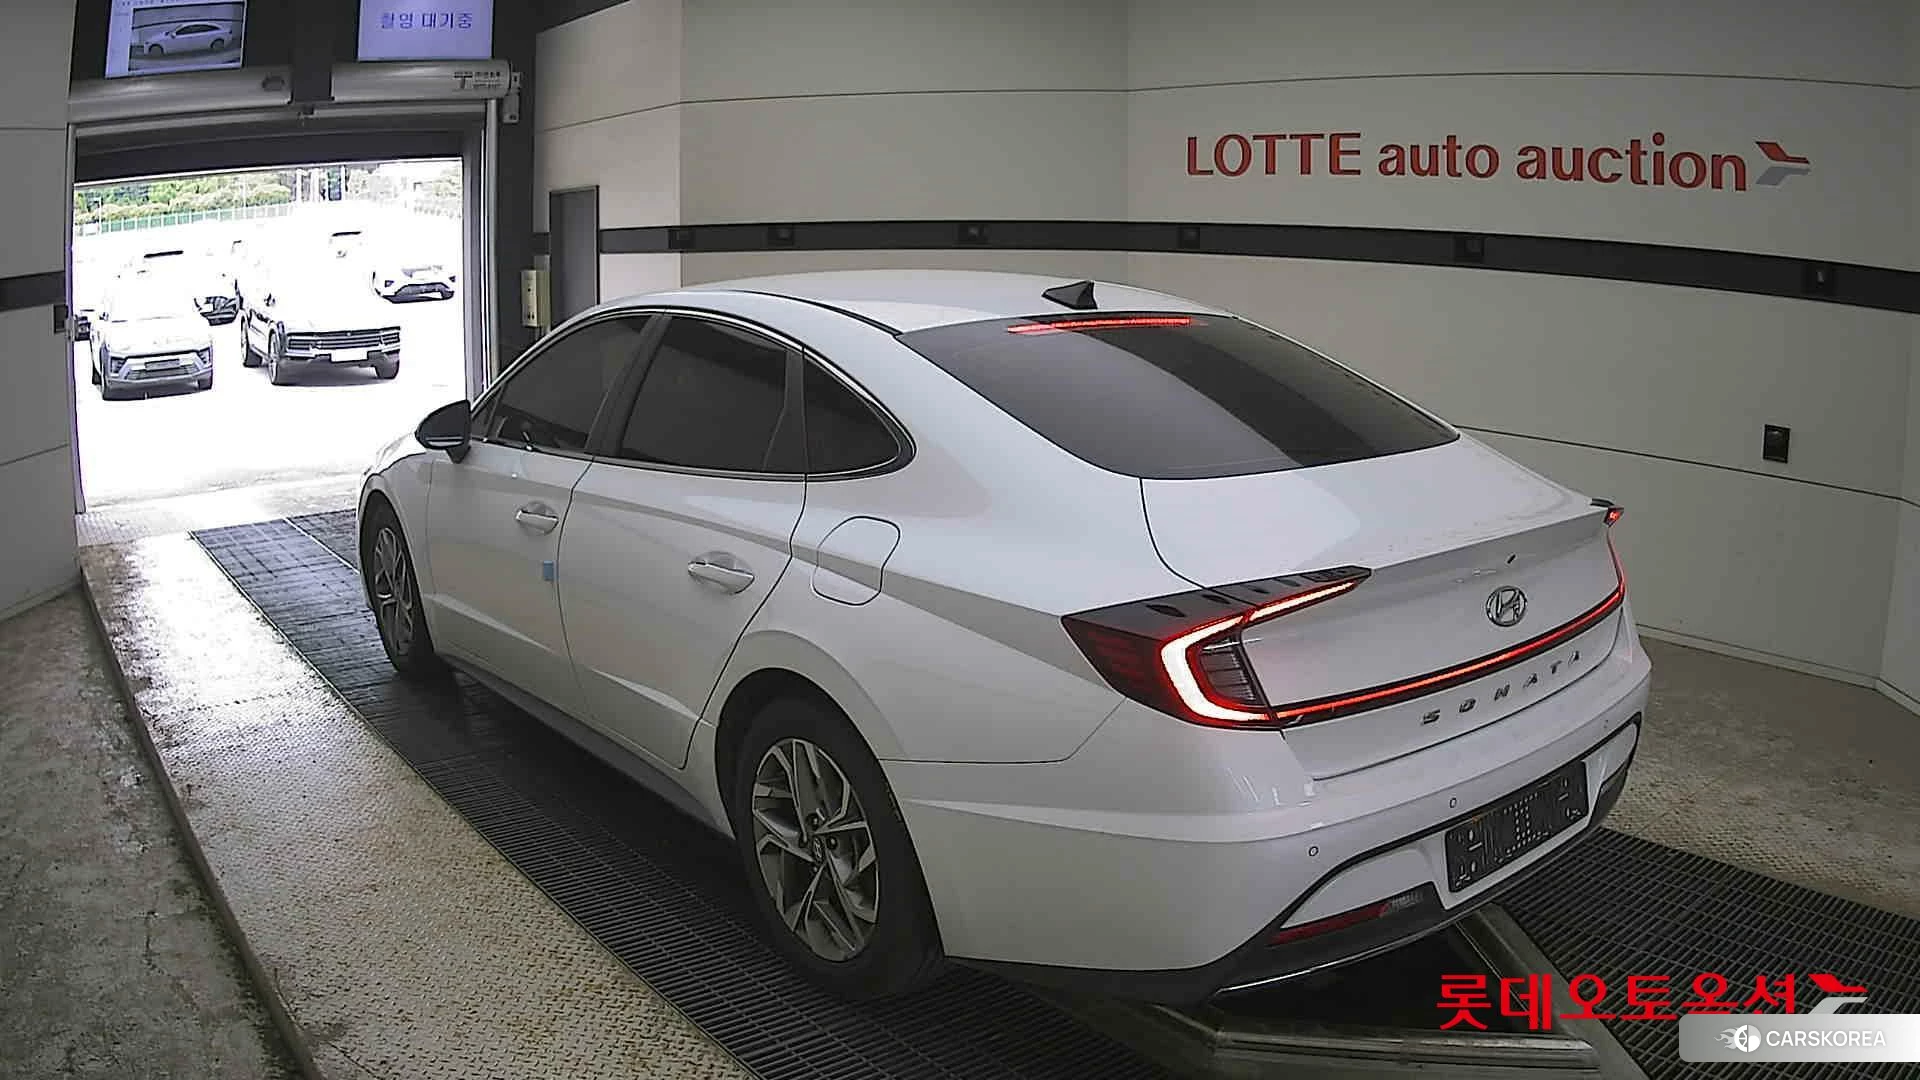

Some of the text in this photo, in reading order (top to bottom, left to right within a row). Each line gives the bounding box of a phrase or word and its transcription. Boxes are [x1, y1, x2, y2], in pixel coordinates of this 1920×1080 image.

[422, 12, 473, 29] 대기중
[1186, 131, 1747, 192] LOTTE auto auction
[1422, 650, 1580, 725] SONATA
